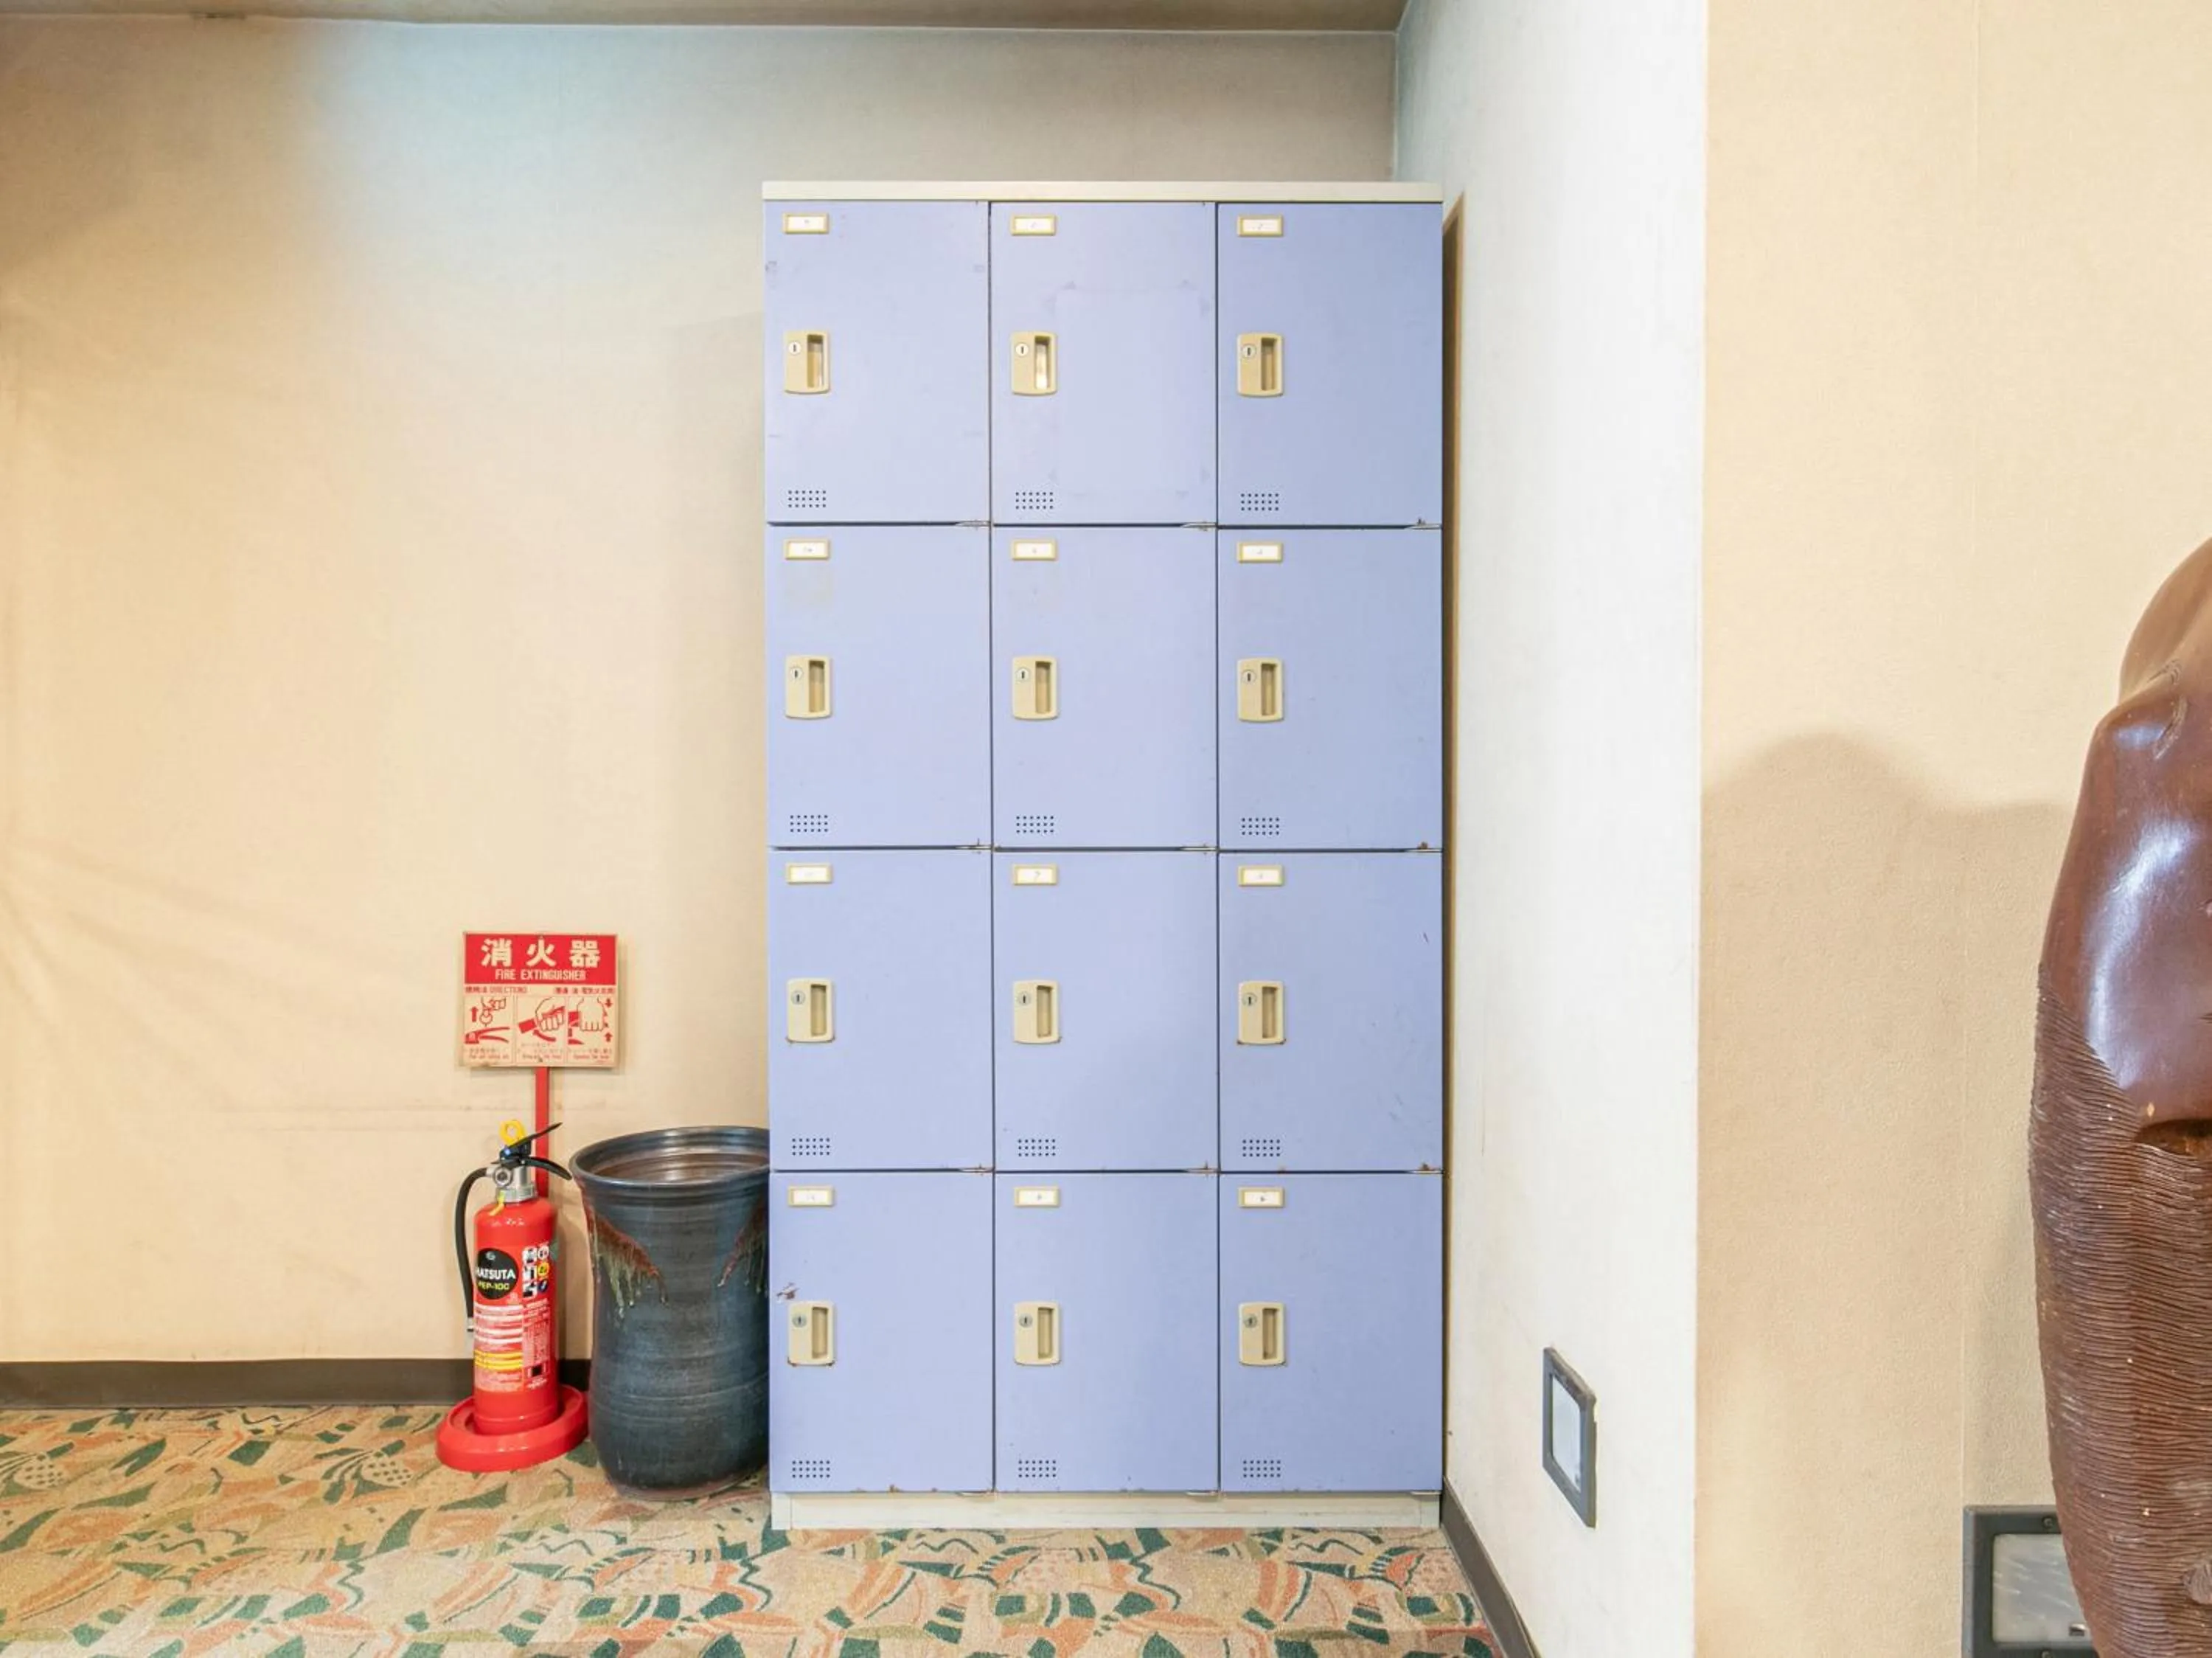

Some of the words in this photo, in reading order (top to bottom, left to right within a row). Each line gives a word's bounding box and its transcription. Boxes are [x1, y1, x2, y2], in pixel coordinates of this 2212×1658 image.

[481, 937, 600, 968] 消火器
[495, 968, 516, 980] FIRE
[520, 968, 586, 980] EXTINGUISHER
